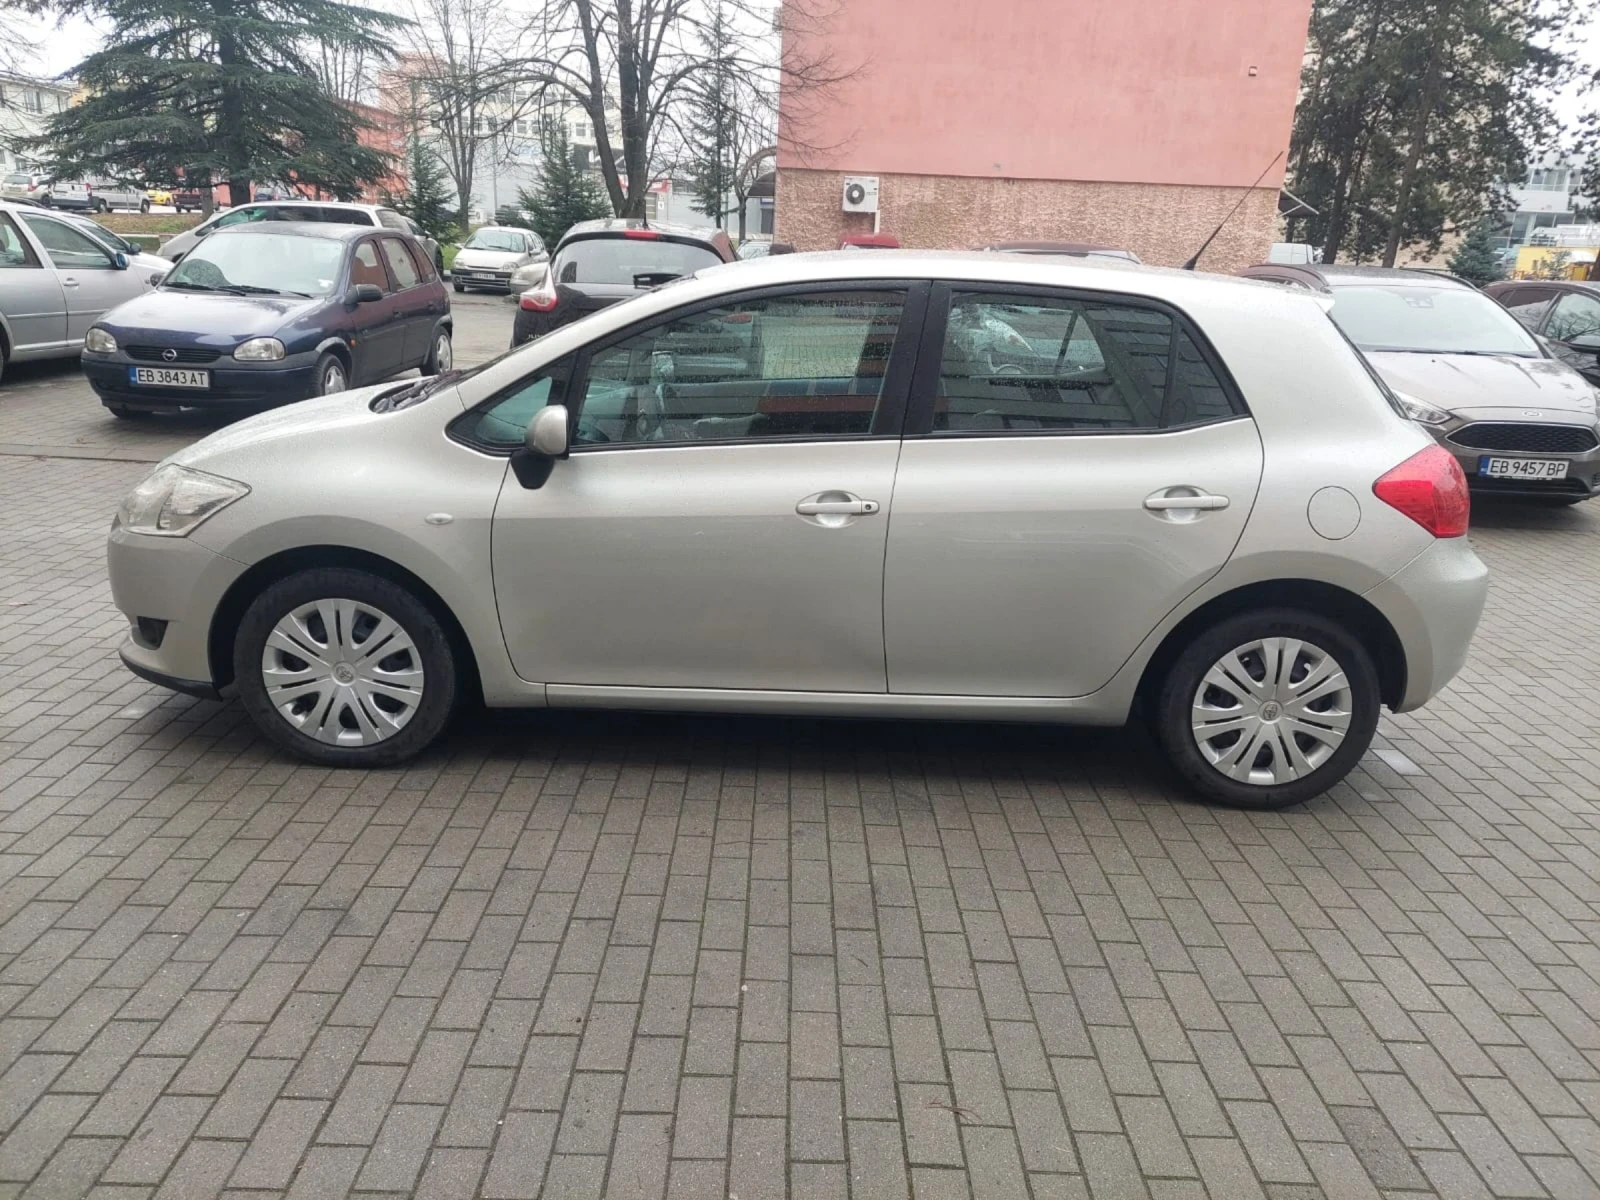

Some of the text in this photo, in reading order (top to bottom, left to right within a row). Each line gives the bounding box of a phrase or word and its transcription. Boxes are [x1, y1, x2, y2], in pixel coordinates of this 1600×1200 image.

[137, 369, 205, 385] EB 3843 AT
[1490, 460, 1566, 476] EB 9457 BP
